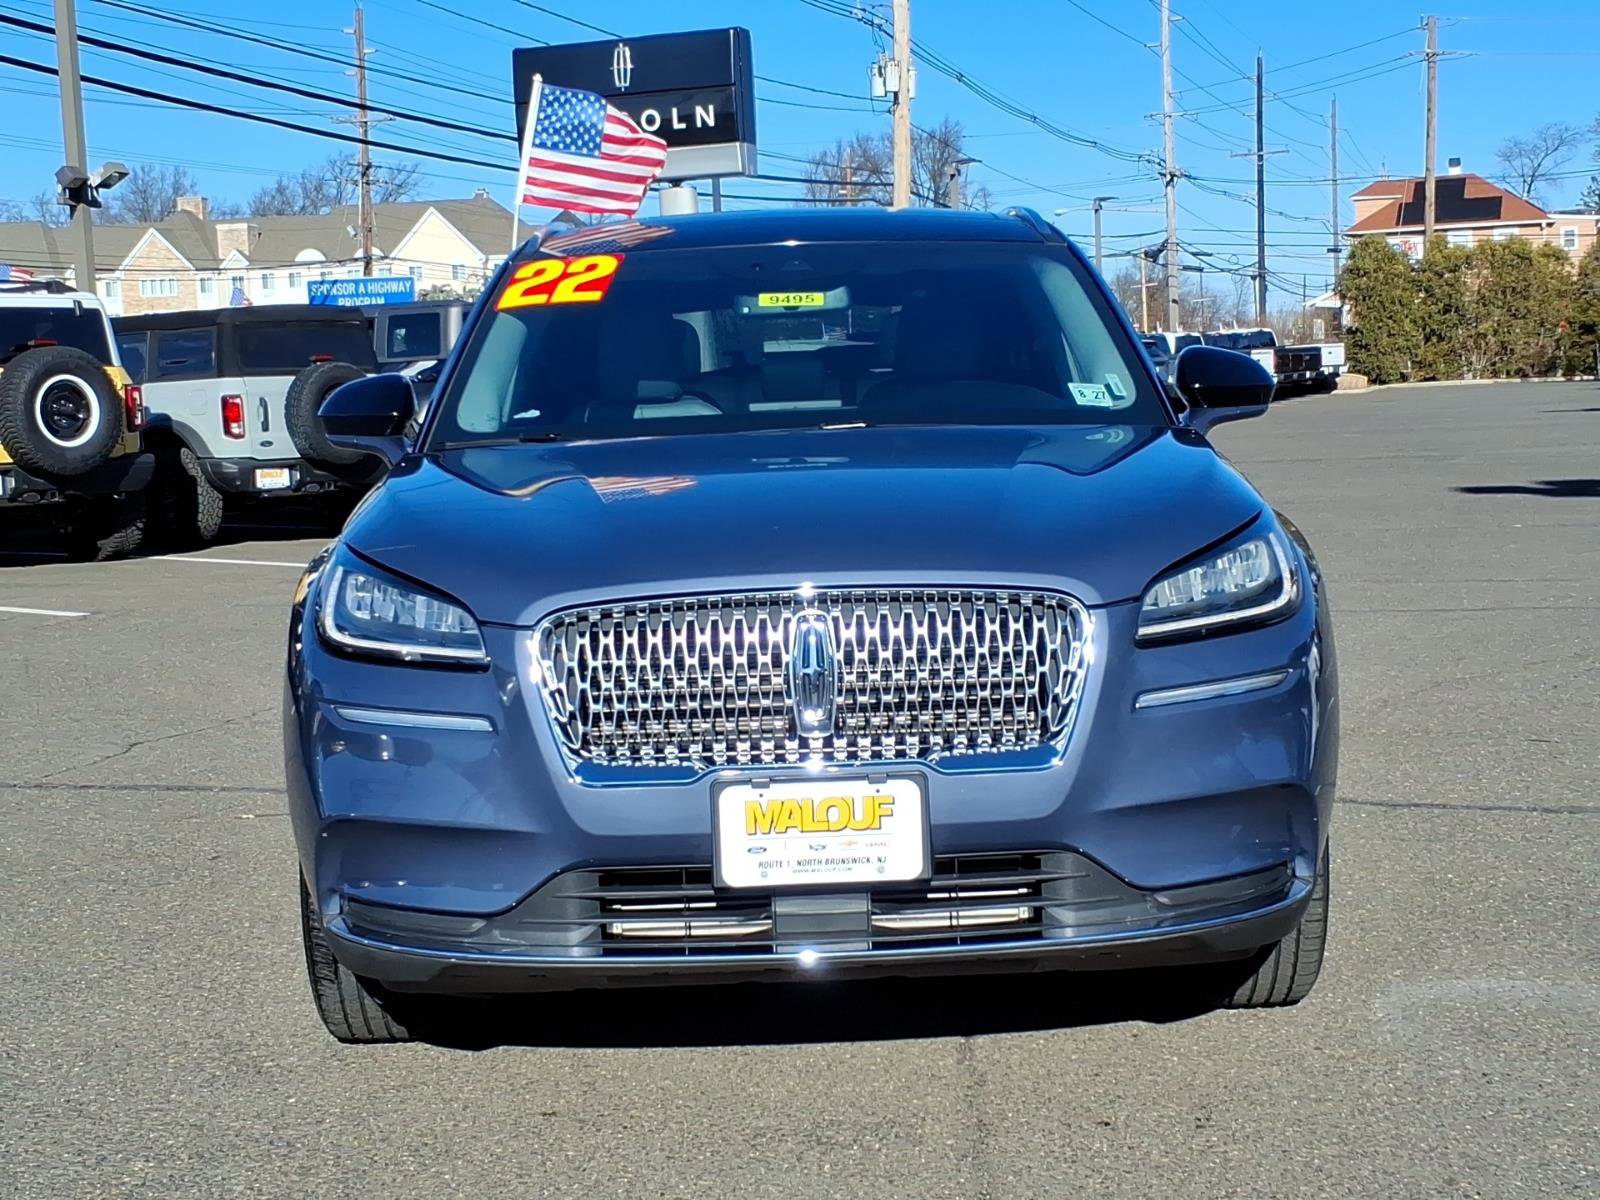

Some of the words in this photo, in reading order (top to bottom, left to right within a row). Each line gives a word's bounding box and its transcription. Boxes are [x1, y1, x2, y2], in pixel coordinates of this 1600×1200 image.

[311, 283, 356, 296] SPONSOR
[358, 283, 366, 294] A
[368, 281, 411, 294] HIGHWAY
[497, 255, 618, 309] 22
[338, 296, 385, 306] PROGRAM
[769, 294, 815, 304] 9495
[1092, 390, 1106, 400] 27
[745, 795, 895, 835] MALOUF
[758, 860, 783, 869] ROUTE
[797, 857, 823, 867] NORTH
[877, 856, 887, 864] NJ
